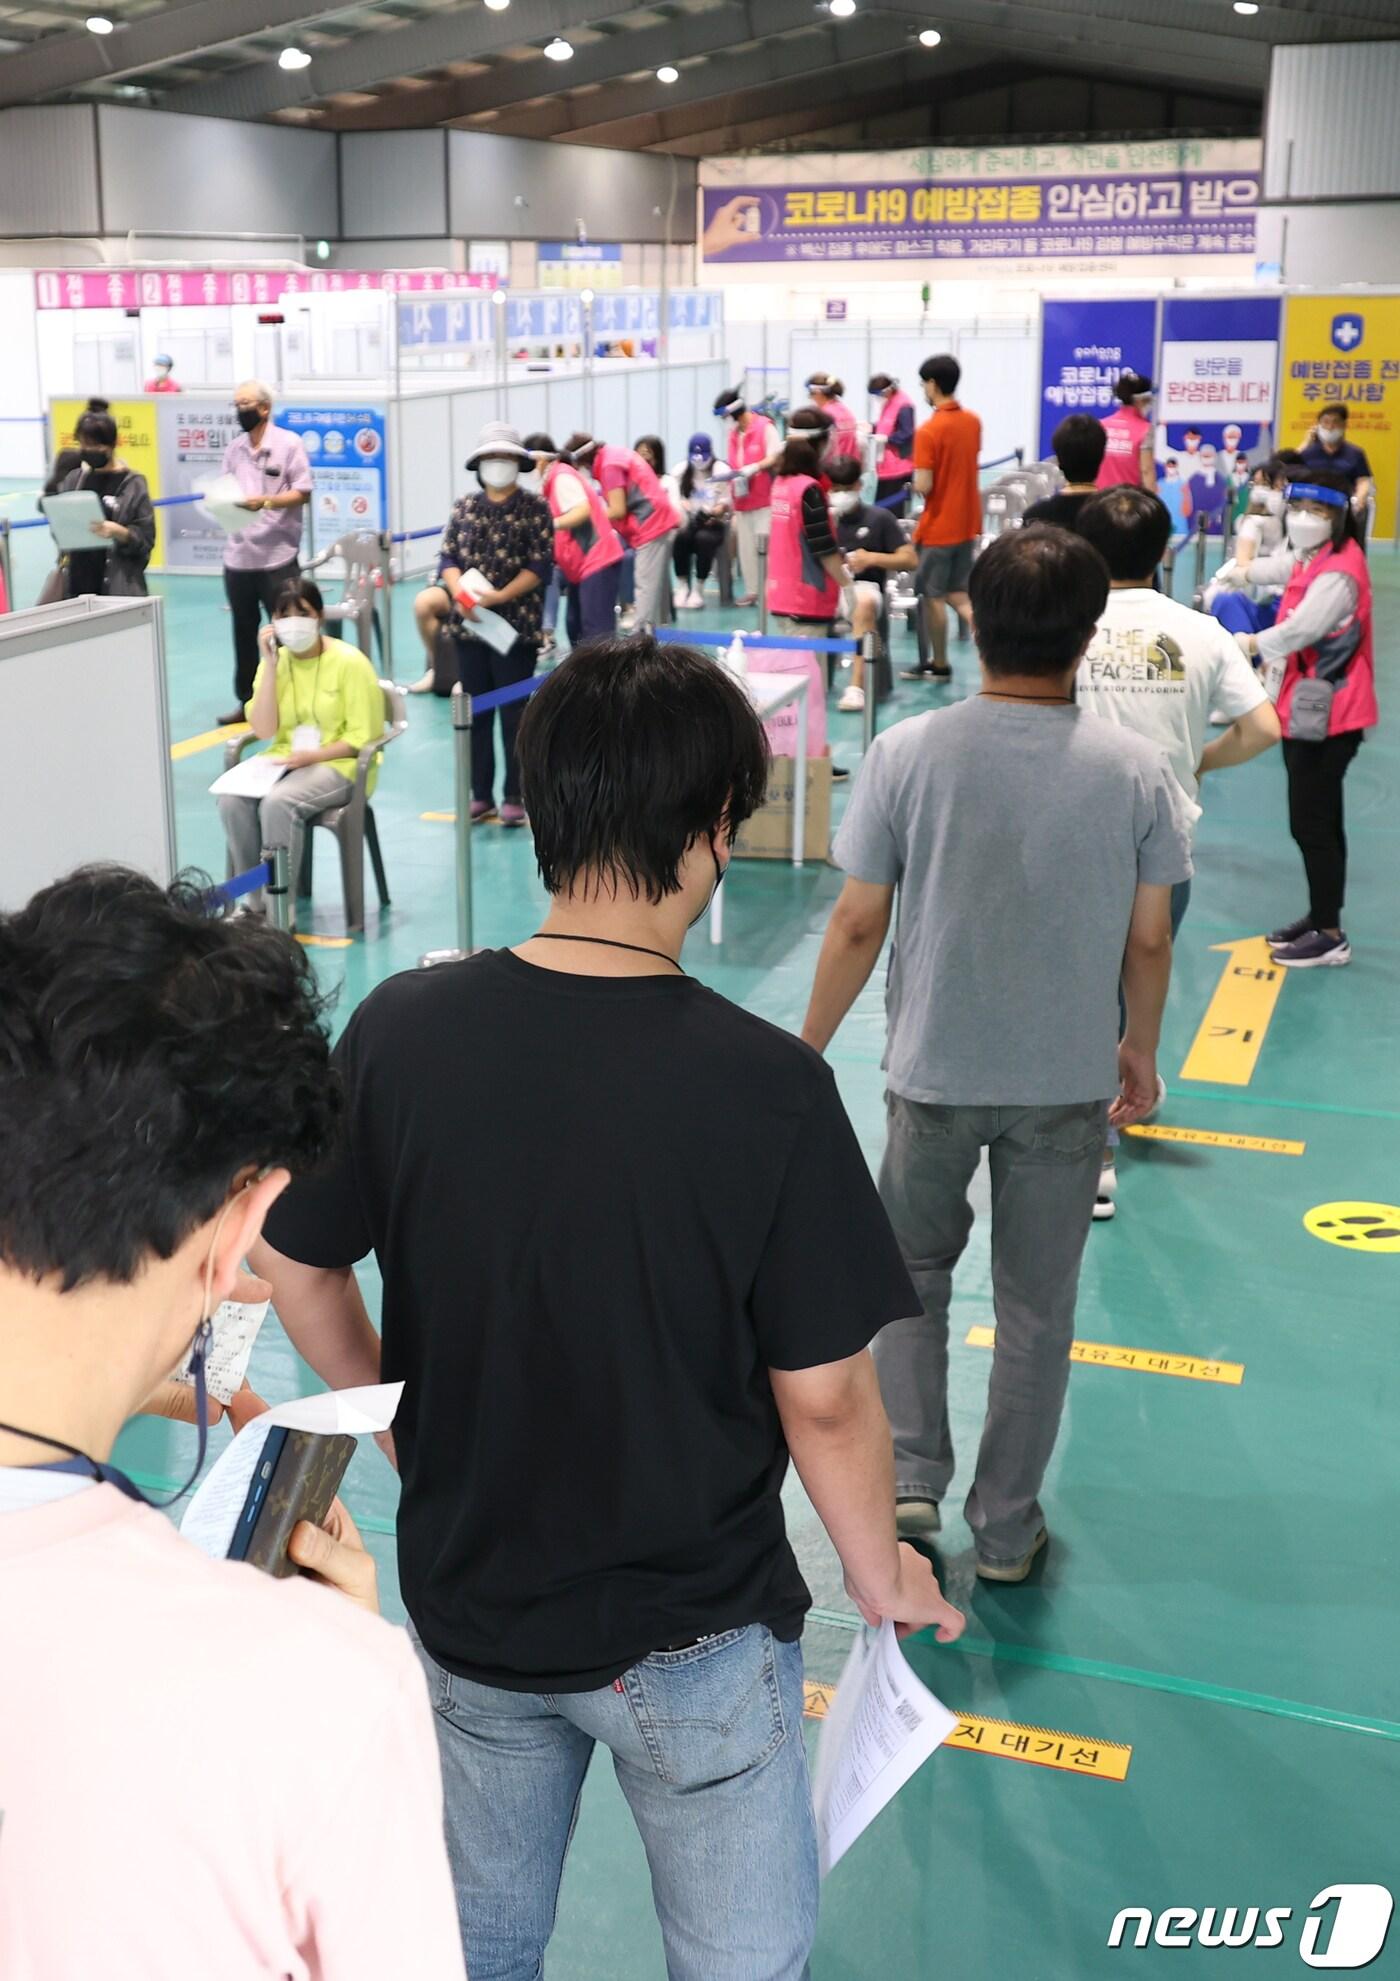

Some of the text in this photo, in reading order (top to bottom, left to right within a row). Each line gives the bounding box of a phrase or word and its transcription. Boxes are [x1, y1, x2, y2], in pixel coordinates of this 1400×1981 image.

[783, 179, 1259, 227] 코로나19 예방접종 안심하고 받으
[895, 239, 935, 254] 마스크
[970, 238, 1022, 253] 거리두기
[1040, 236, 1093, 252] 코로나19
[1194, 357, 1243, 376] 방문을
[1291, 360, 1371, 379] 예방접종
[1045, 386, 1123, 407] 예방접종
[1303, 382, 1385, 402] 주의사항
[178, 428, 240, 448] 금연입니
[1085, 646, 1145, 663] ORTH
[1090, 662, 1145, 681] FACE
[1077, 685, 1100, 693] EVER
[1131, 686, 1185, 695] EXPLORING
[1072, 1344, 1221, 1377] 격유지 대기선
[954, 1722, 1100, 1769] 지 대기선
